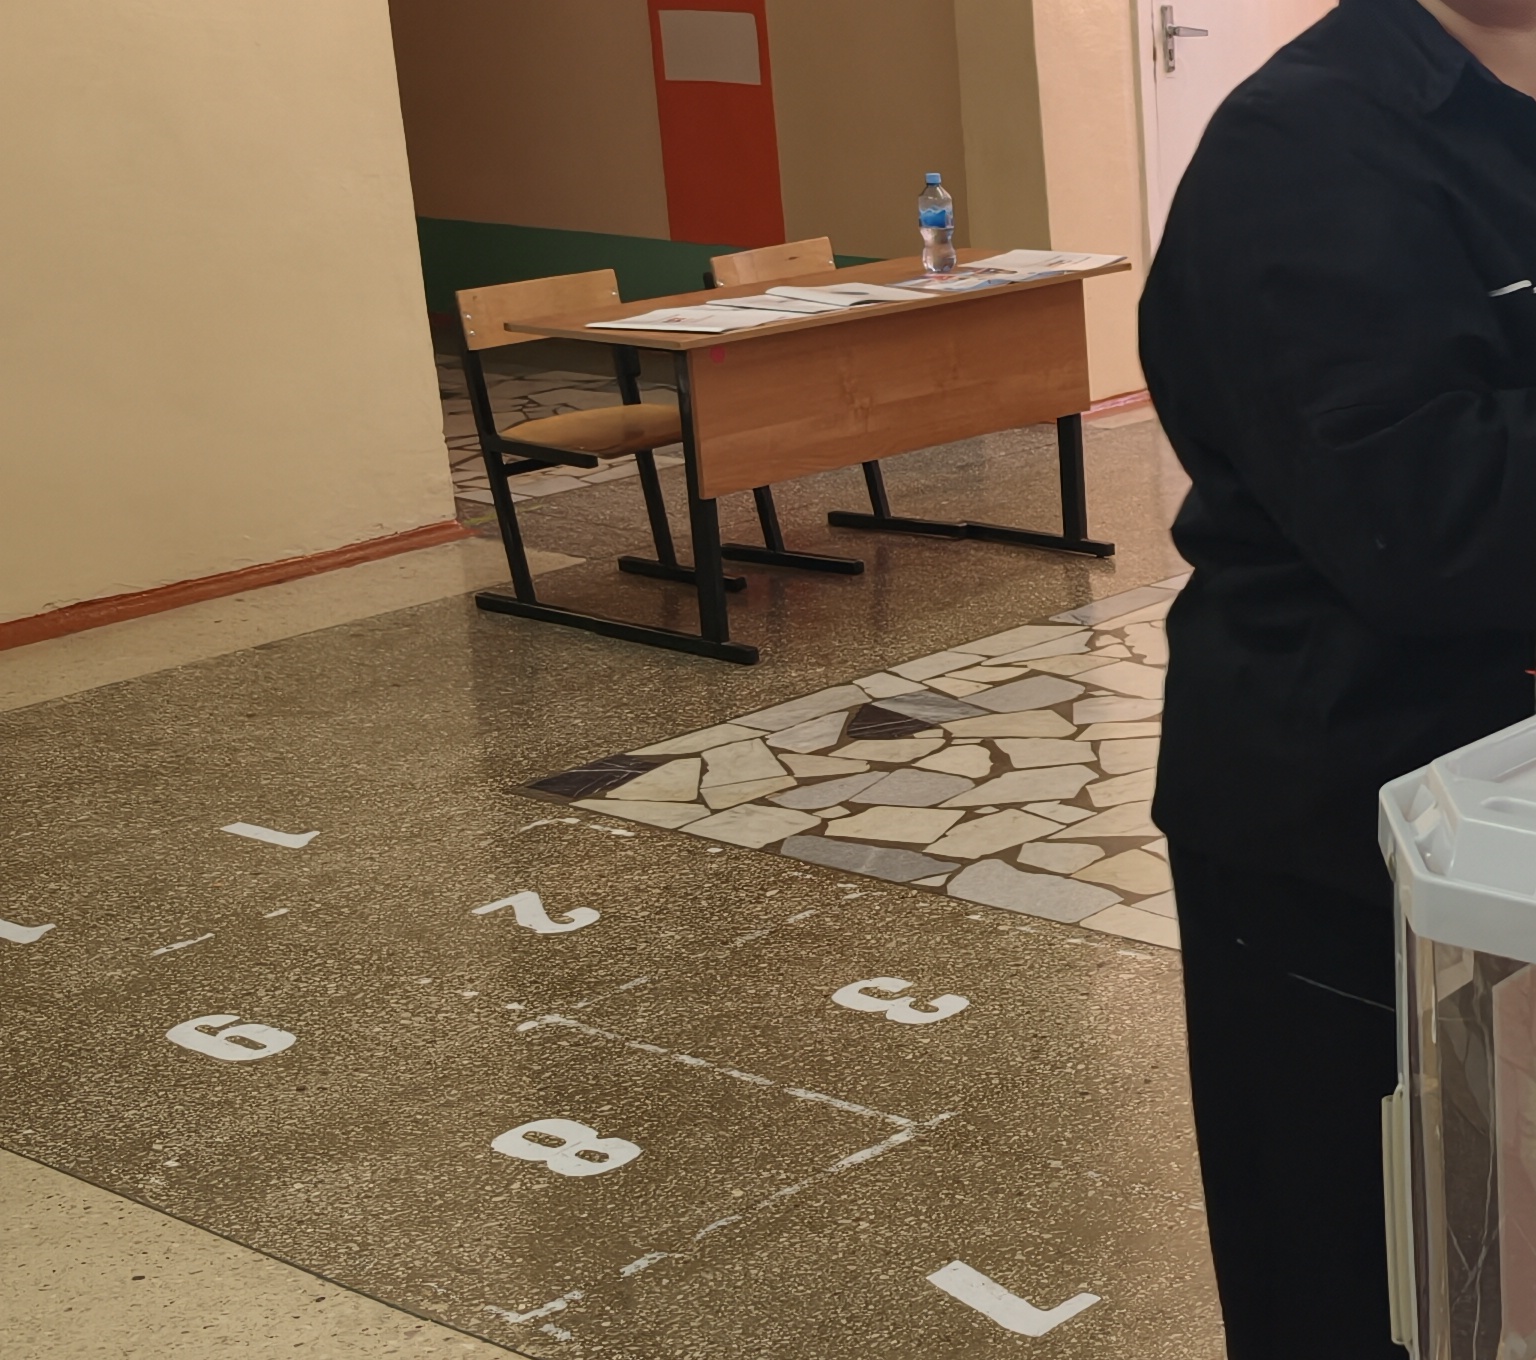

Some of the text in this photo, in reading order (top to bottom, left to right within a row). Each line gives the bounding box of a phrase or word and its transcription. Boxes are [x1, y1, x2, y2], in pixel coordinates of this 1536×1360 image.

[224, 823, 317, 847] 1
[474, 892, 599, 933] 2
[832, 977, 969, 1023] 3
[491, 1119, 641, 1176] 8
